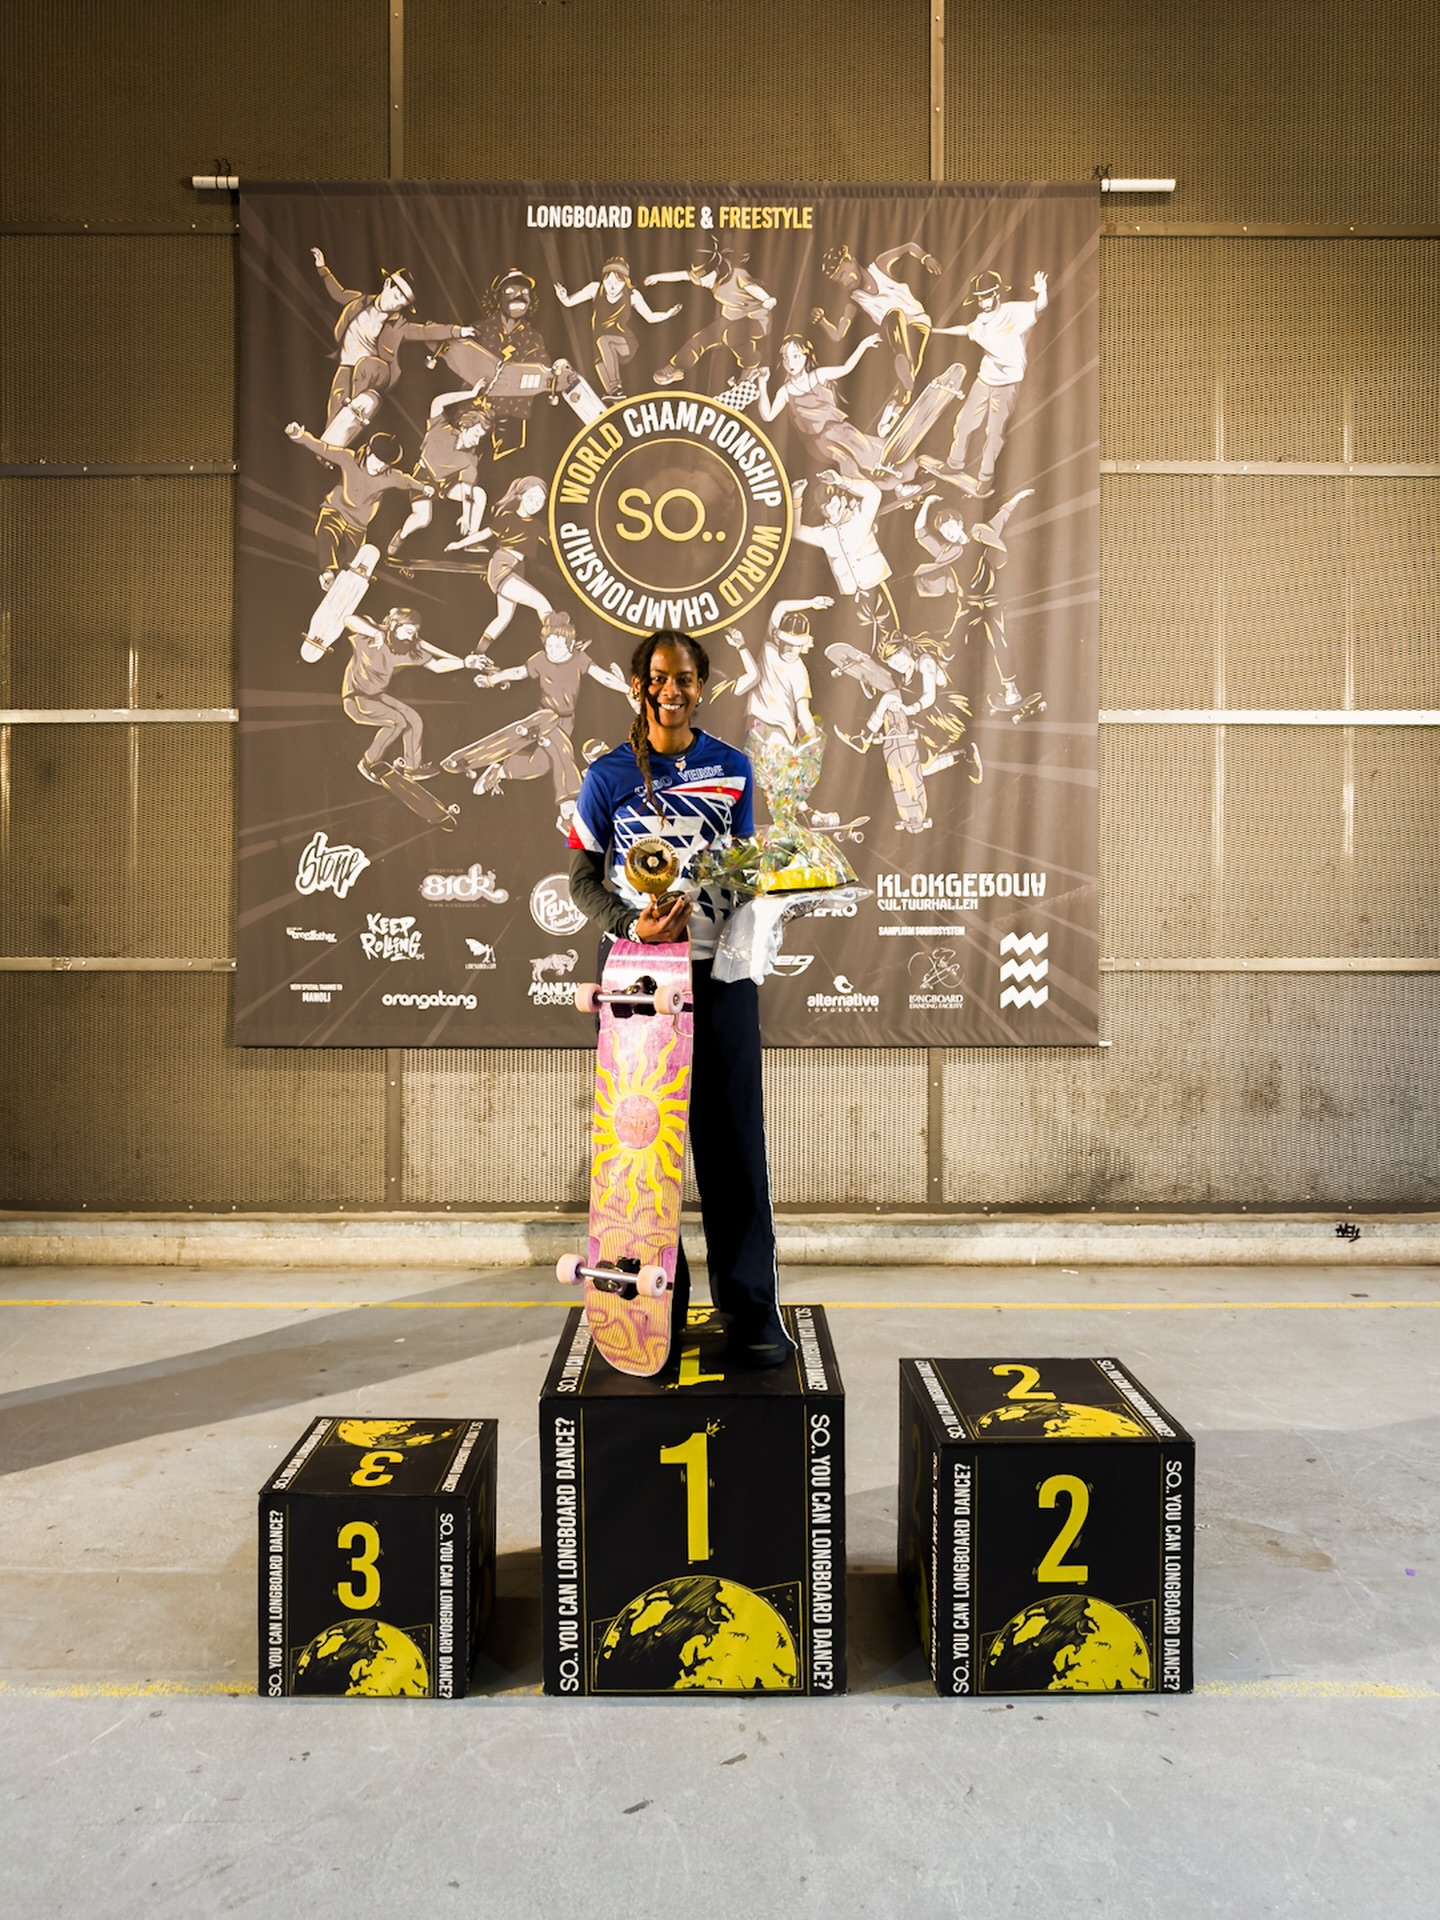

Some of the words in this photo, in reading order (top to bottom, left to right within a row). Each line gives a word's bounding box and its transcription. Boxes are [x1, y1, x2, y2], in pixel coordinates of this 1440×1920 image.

[527, 205, 632, 228] LONGBOARD
[637, 206, 696, 228] DANCE
[700, 206, 714, 229] &
[719, 206, 813, 229] FREESTYLE
[560, 422, 624, 504] WORLD
[623, 401, 782, 507] CHAMPIONSHIP
[560, 522, 720, 629] CHAMPIONSHIP
[718, 525, 782, 607] WORLD
[677, 765, 725, 783] VERDE
[876, 872, 1047, 898] KLOKGEBOUW
[877, 898, 979, 912] CULTUURHALLEN
[366, 912, 417, 937] KEEP
[381, 989, 478, 1010] orangatang
[533, 994, 575, 1006] BOARDS
[807, 993, 880, 1007] alternative
[909, 994, 964, 1003] LONGBOARD
[992, 1363, 1057, 1400] 2
[555, 1417, 576, 1479] DANCE?
[350, 1450, 404, 1487] 3
[811, 1455, 831, 1487] YOU
[659, 1431, 711, 1563] 1
[954, 1462, 971, 1515] DANCE?
[811, 1492, 831, 1524] CAN
[1165, 1494, 1182, 1520] YOU
[269, 1510, 284, 1552] DANCE?
[556, 1484, 577, 1579] LONGBOARD
[1037, 1474, 1090, 1584] 2
[1164, 1524, 1182, 1551] CAN
[337, 1521, 381, 1611] 3
[439, 1540, 454, 1562] YOU
[953, 1518, 971, 1598] LONGBOARD
[269, 1555, 283, 1620] LONGBOARD
[439, 1565, 454, 1586] CAN
[811, 1529, 833, 1624] LONGBOARD
[558, 1583, 578, 1615] CAN
[1164, 1555, 1182, 1635] LONGBOARD
[439, 1590, 454, 1654] LONGBOARD
[953, 1602, 970, 1629] CAN
[268, 1622, 283, 1645] CAN
[558, 1620, 579, 1651] YOU
[953, 1632, 970, 1660] YOU
[268, 1651, 283, 1669] YOU
[812, 1628, 834, 1690] DANCE?
[1163, 1638, 1181, 1691] DANCE?
[439, 1656, 454, 1699] DANCE?
